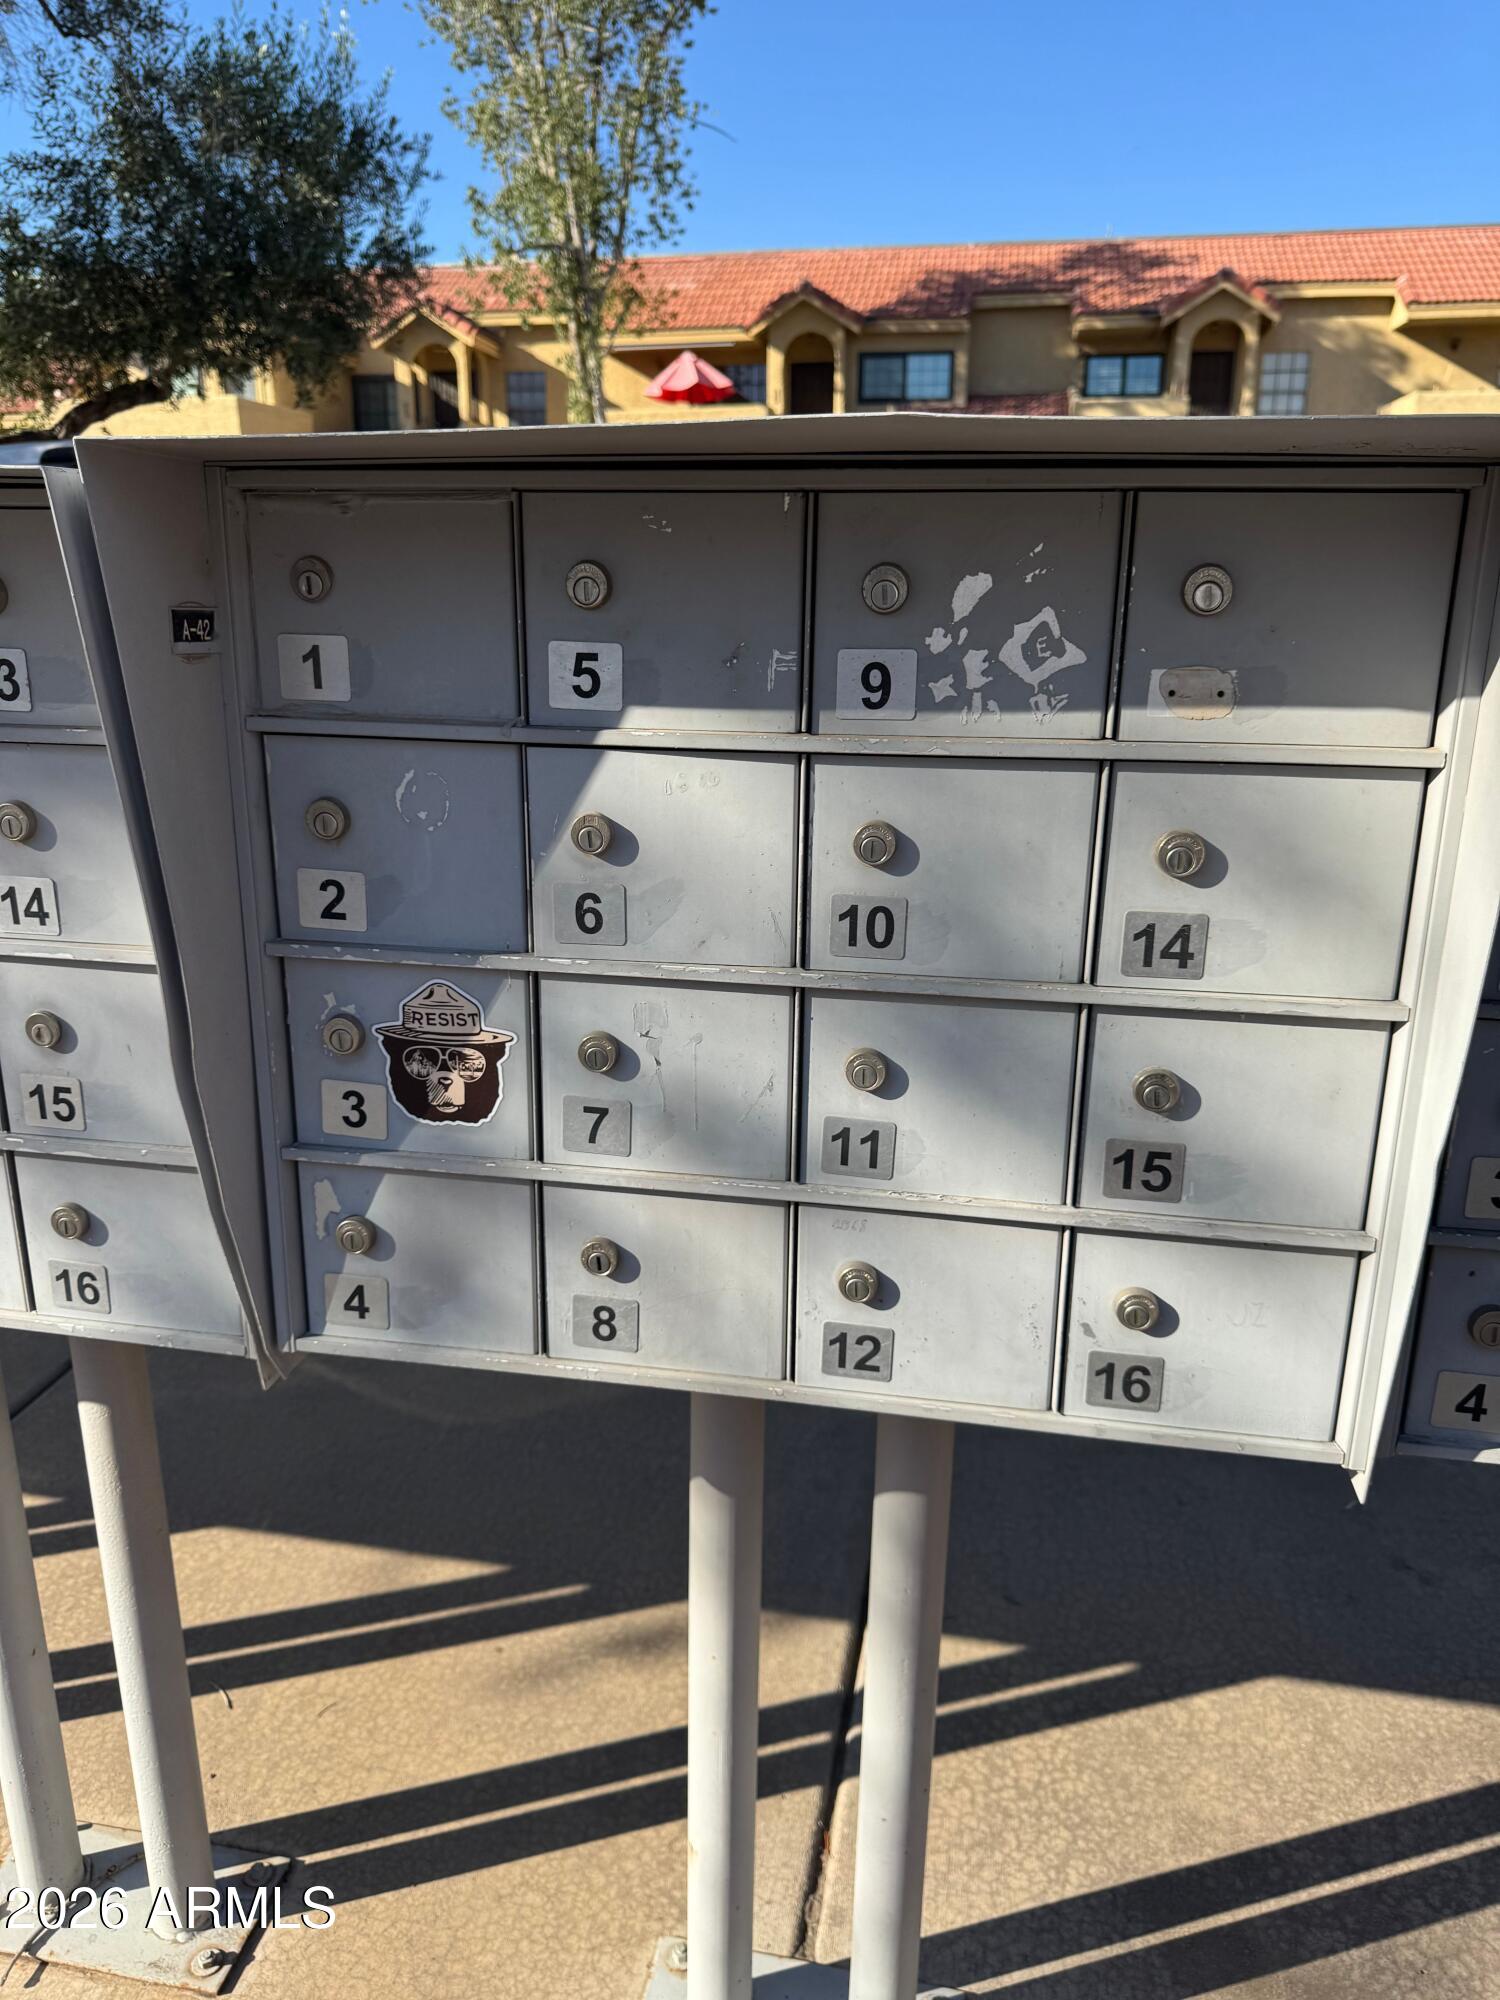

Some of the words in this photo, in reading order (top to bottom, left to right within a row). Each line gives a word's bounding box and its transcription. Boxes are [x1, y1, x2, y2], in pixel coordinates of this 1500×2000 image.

[183, 618, 212, 641] A-42
[301, 644, 323, 690] 1
[571, 652, 601, 699] 5
[860, 661, 892, 710] 9
[1, 885, 50, 927] 14
[319, 878, 347, 921] 2
[574, 892, 604, 935] 6
[838, 904, 895, 949] 10
[1132, 922, 1195, 970] 14
[411, 1010, 479, 1027] RESIST
[28, 1083, 76, 1123] 15
[341, 1089, 368, 1129] 3
[582, 1105, 610, 1144] 7
[831, 1126, 880, 1170] 11
[1112, 1148, 1173, 1193] 15
[55, 1268, 101, 1305] 16
[343, 1284, 370, 1320] 4
[591, 1305, 618, 1342] 8
[828, 1331, 882, 1373] 12
[1094, 1362, 1152, 1404] 16
[1454, 1383, 1488, 1423] 4
